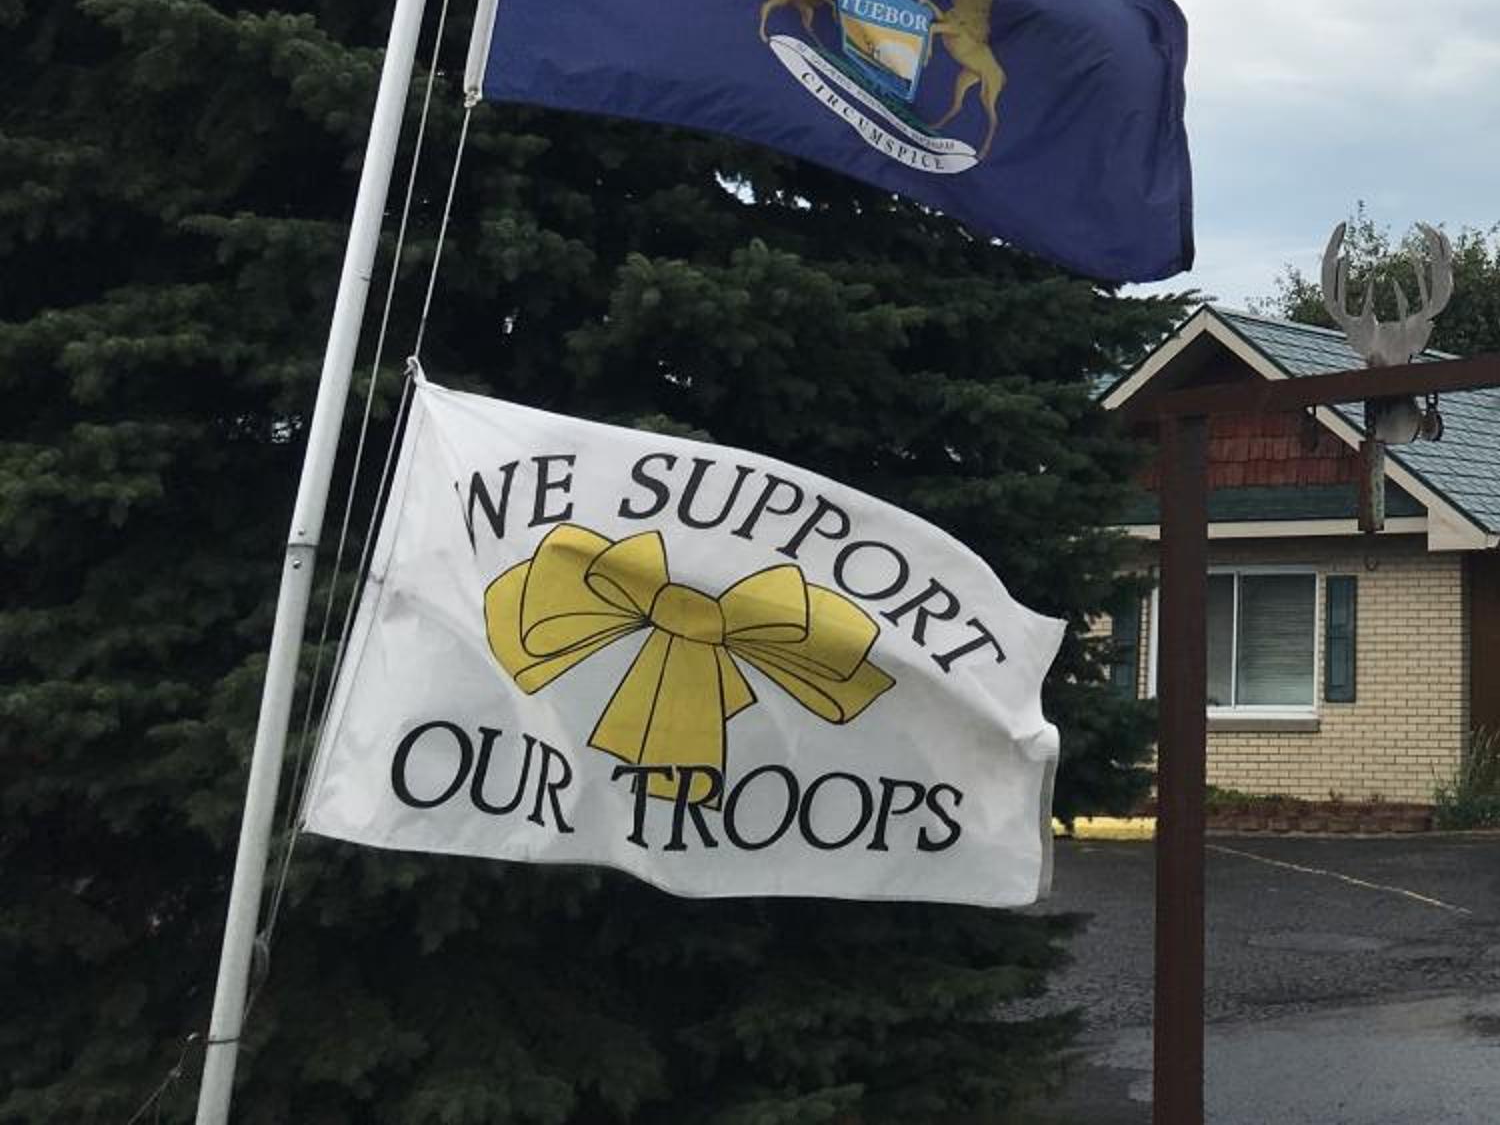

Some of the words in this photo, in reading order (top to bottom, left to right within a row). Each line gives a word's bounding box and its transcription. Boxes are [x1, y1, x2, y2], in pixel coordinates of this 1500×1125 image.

[801, 71, 945, 170] CIRCUMSPICE
[455, 454, 577, 555] WE
[617, 452, 1007, 673] SUPPORT
[390, 720, 575, 834] OUR
[611, 763, 963, 853] TROOPS
